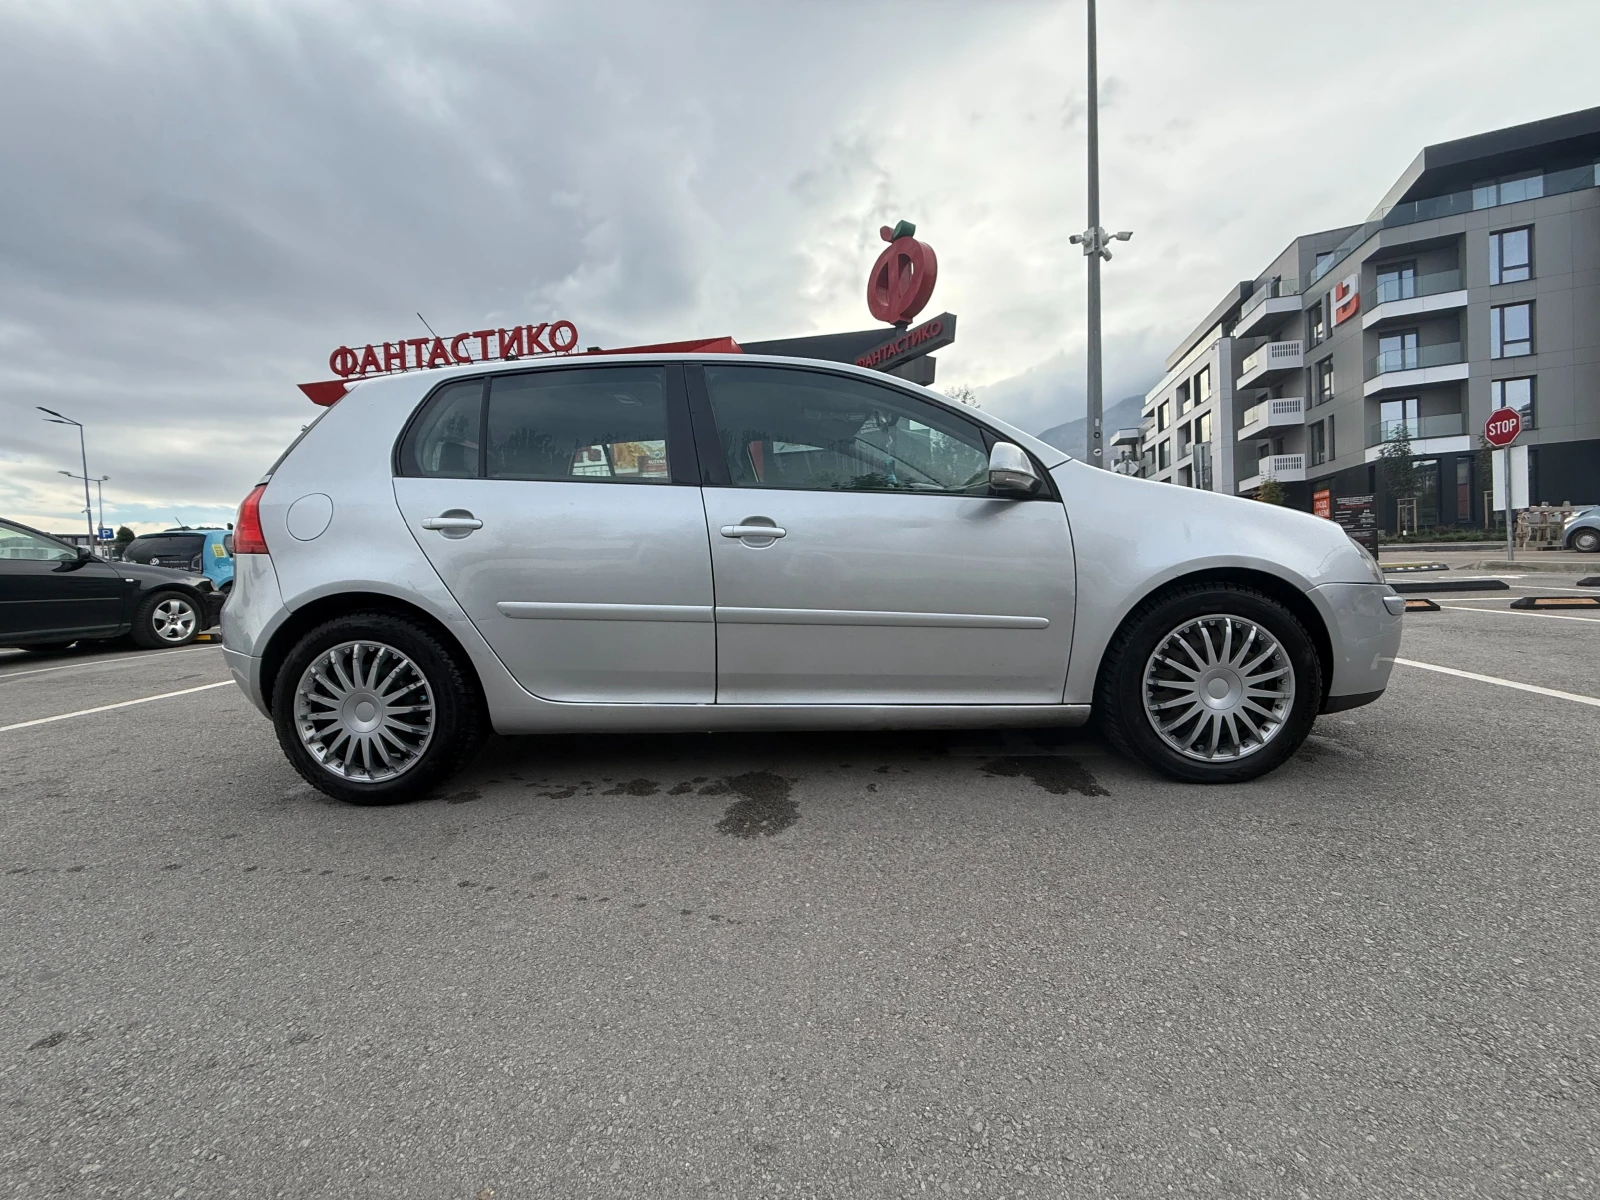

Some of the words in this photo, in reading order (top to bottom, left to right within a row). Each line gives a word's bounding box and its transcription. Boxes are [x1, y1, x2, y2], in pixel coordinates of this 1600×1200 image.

[329, 320, 578, 377] ФАНТАСТИКО
[1489, 418, 1517, 436] STOP
[103, 530, 111, 538] P
